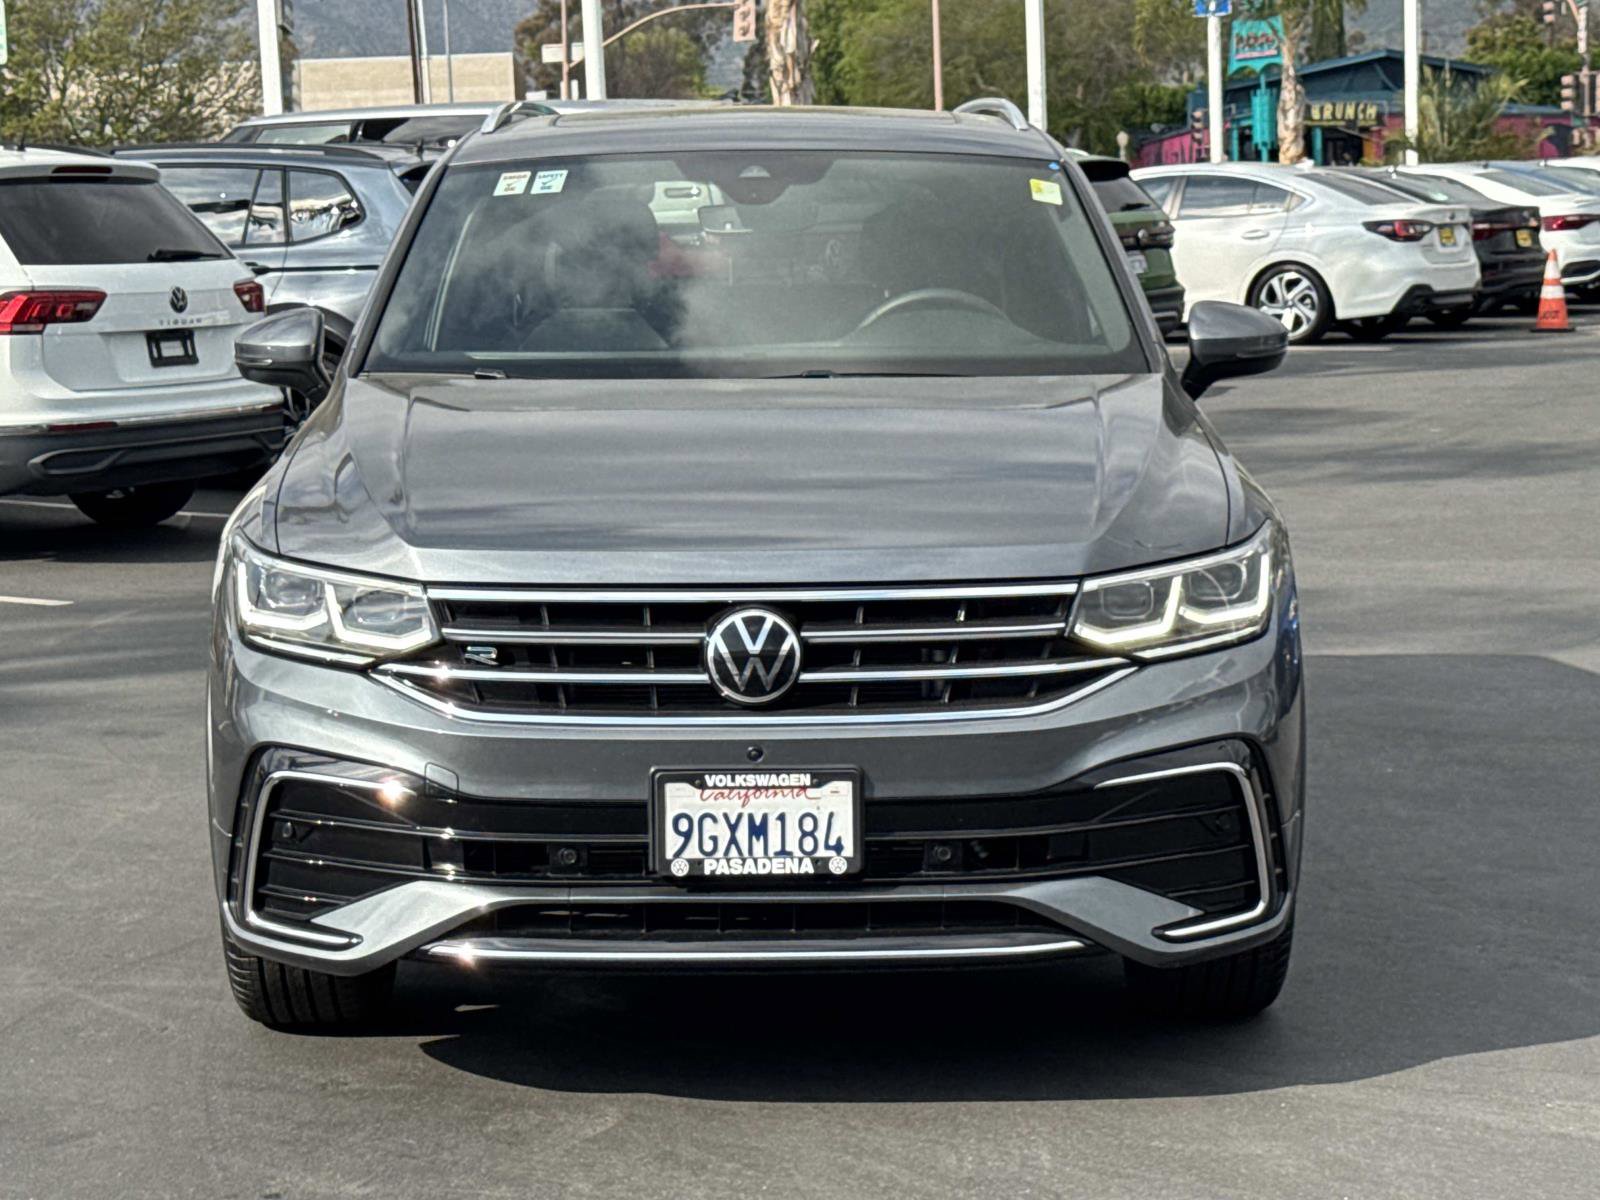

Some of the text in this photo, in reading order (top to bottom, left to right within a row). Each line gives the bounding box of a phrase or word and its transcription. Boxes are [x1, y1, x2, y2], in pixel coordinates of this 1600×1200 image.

[1311, 101, 1378, 121] BRUNCH
[703, 773, 811, 788] VOLKSWAGEN
[671, 811, 845, 858] 9GXM184
[703, 857, 815, 875] PASADENA
